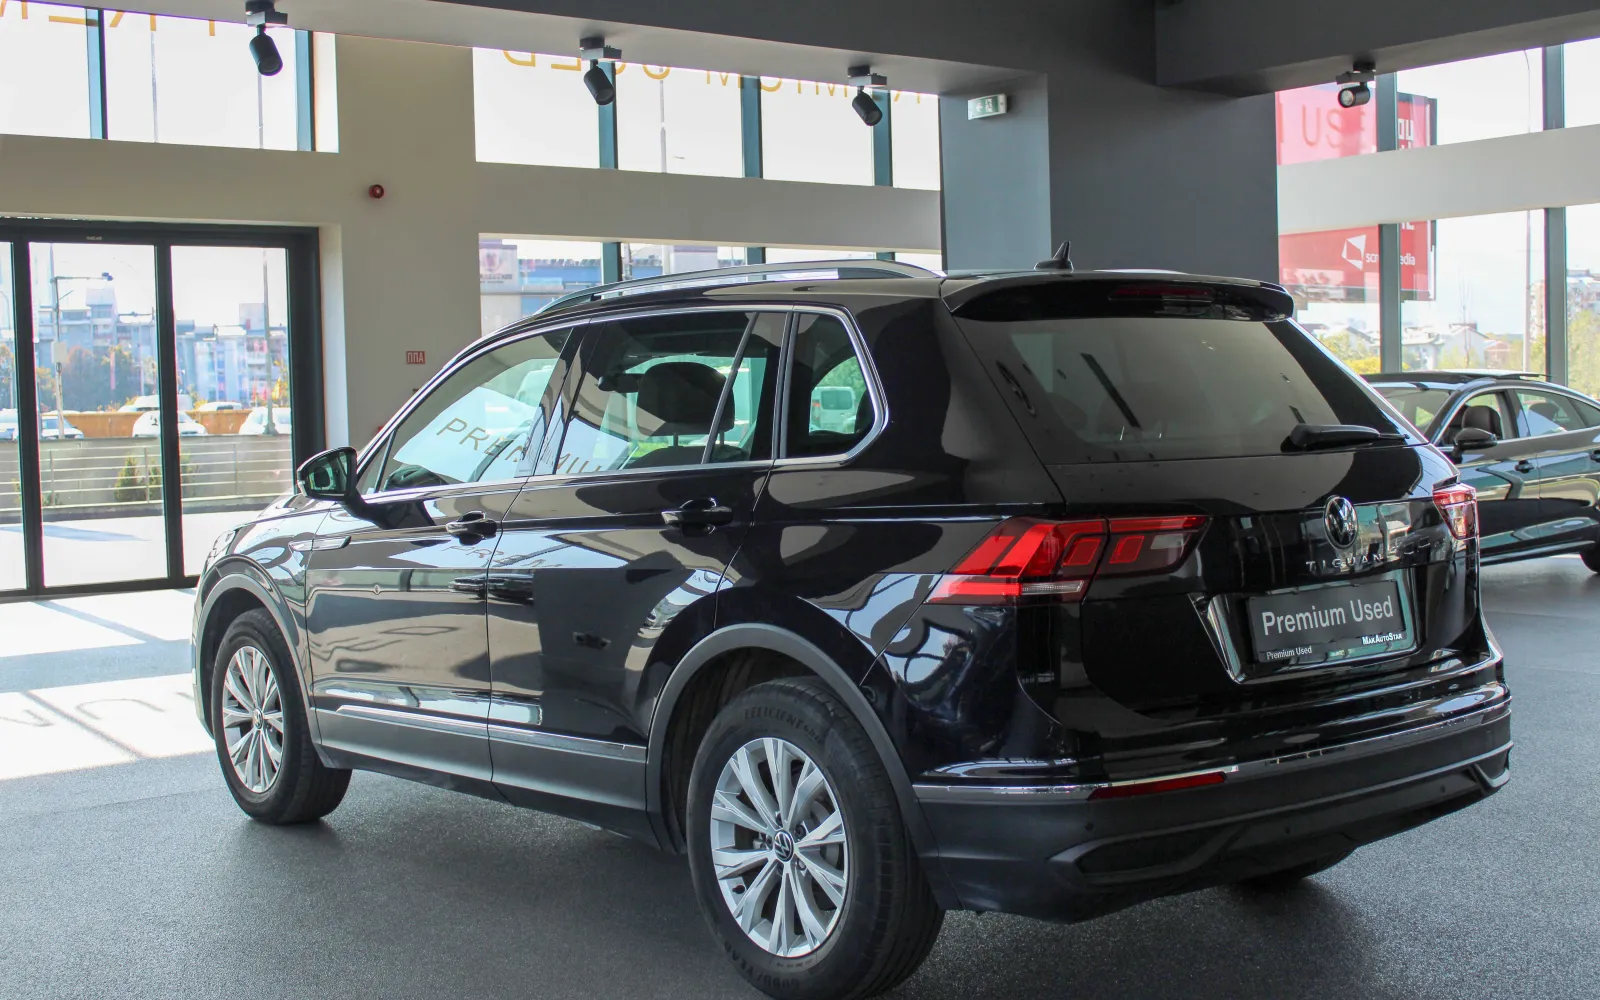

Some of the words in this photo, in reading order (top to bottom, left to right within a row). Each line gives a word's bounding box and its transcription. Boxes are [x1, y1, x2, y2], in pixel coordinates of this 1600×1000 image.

[1305, 553, 1384, 572] TIGUAN
[1262, 605, 1346, 636] Premium
[1350, 595, 1394, 622] Used
[1266, 649, 1295, 660] Premium
[1295, 645, 1313, 656] Used
